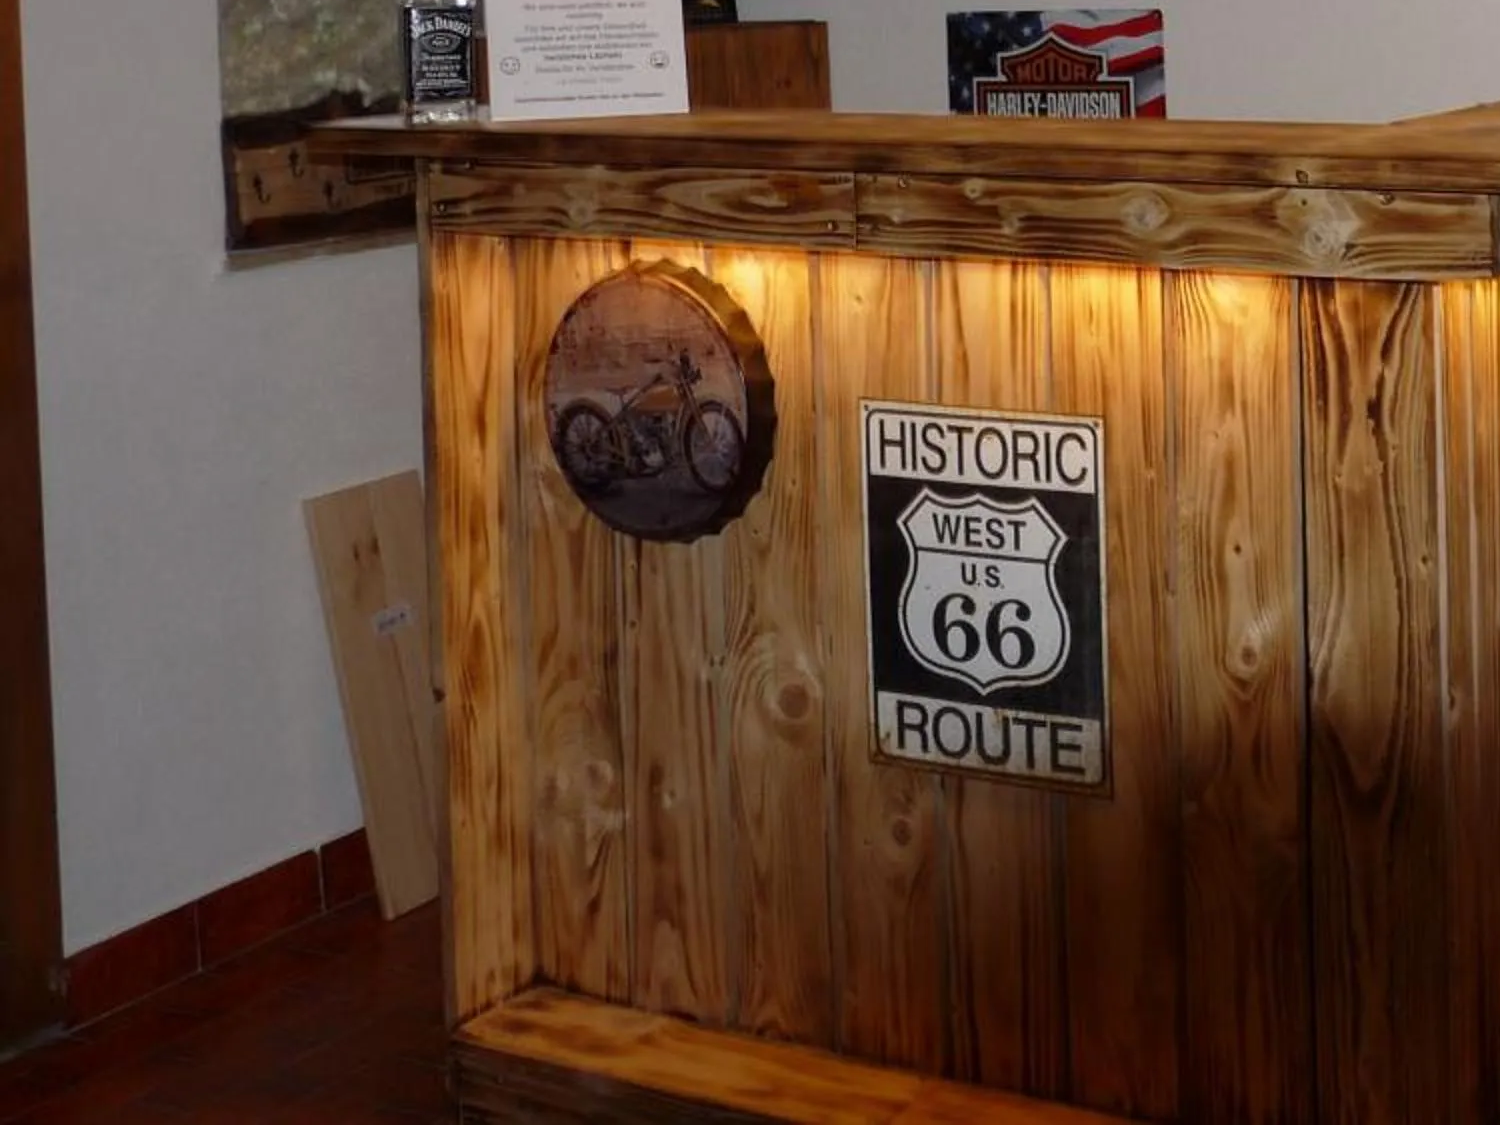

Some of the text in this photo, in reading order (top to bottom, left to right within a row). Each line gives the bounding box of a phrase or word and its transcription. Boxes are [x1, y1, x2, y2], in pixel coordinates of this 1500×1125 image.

[1015, 52, 1088, 83] MOTOR
[986, 90, 1121, 119] HARLEY-DAVIDSON
[878, 417, 1088, 487] HISTORIC
[932, 512, 1027, 553] WEST
[961, 562, 1005, 589] U.S.
[932, 592, 1036, 670] 66
[896, 700, 1087, 776] ROUTE
